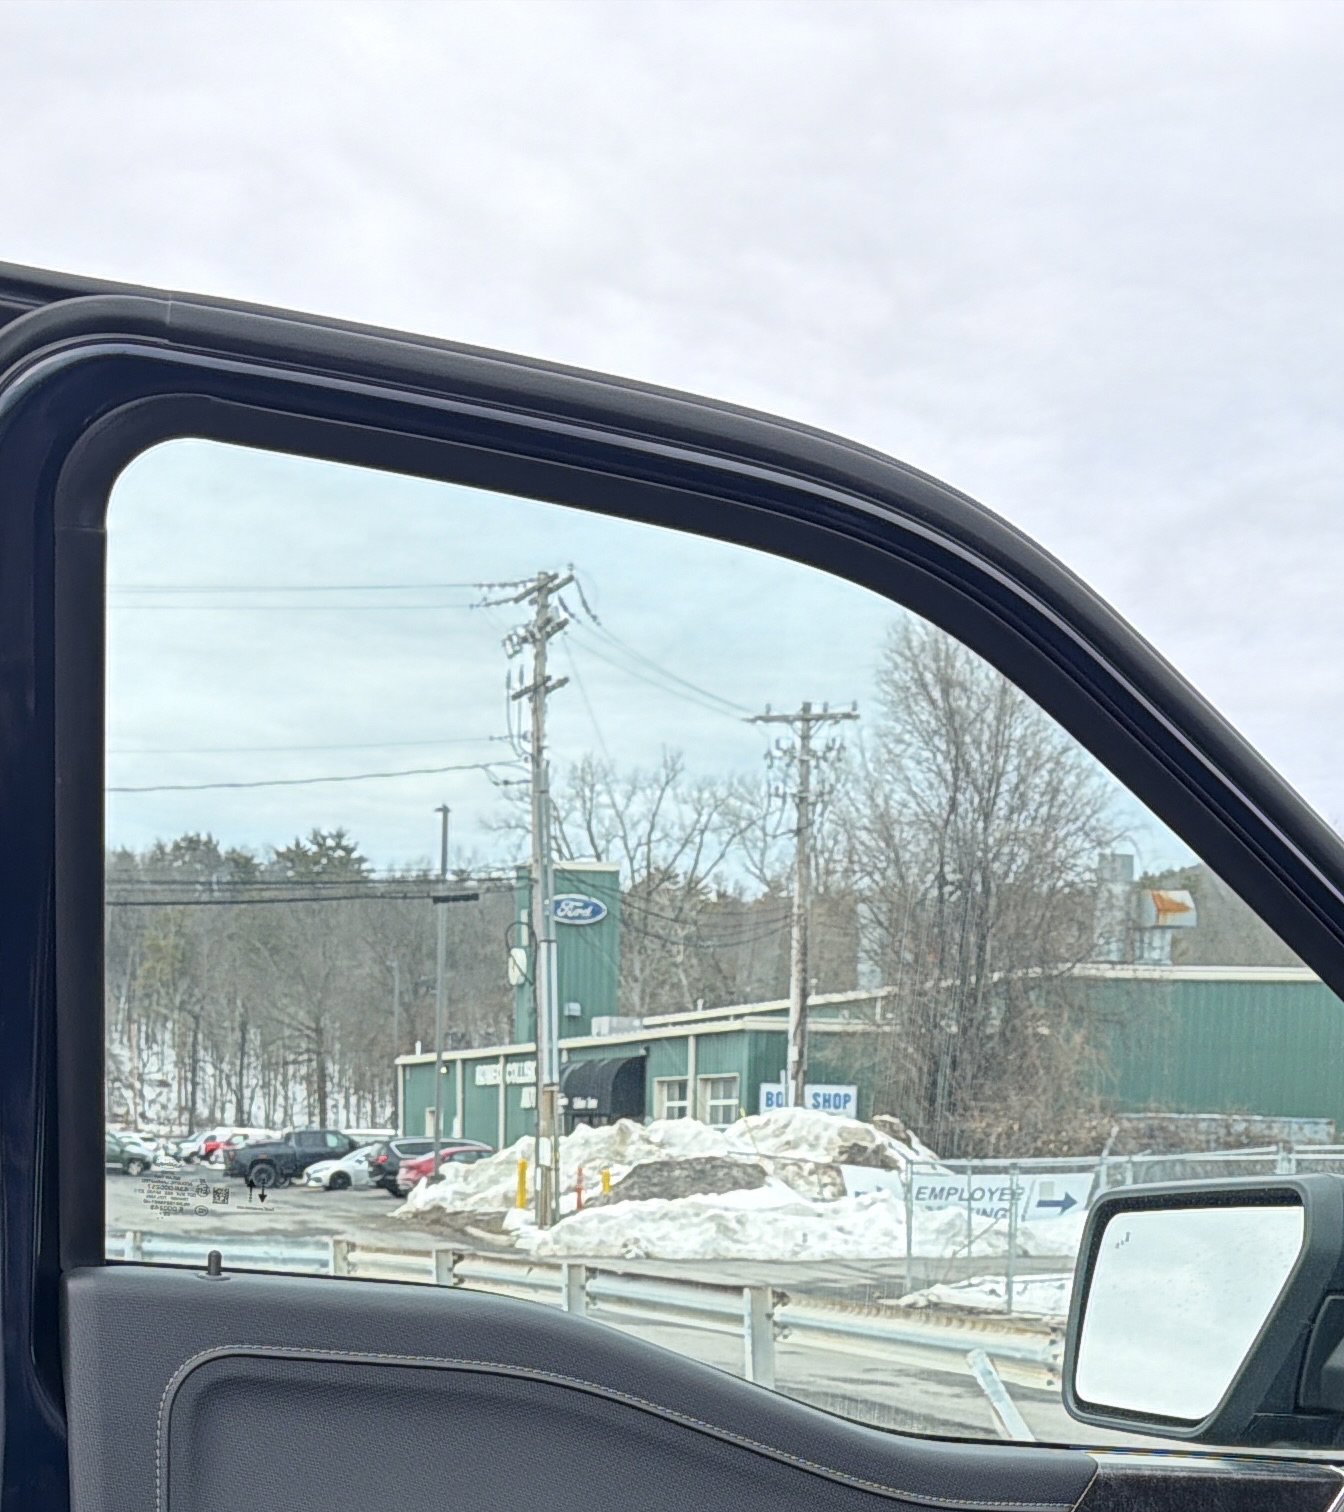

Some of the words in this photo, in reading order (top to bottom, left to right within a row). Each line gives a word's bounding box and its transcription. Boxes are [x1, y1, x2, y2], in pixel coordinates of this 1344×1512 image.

[557, 900, 594, 917] Ford
[765, 1091, 784, 1108] BO
[811, 1092, 852, 1109] SHOP
